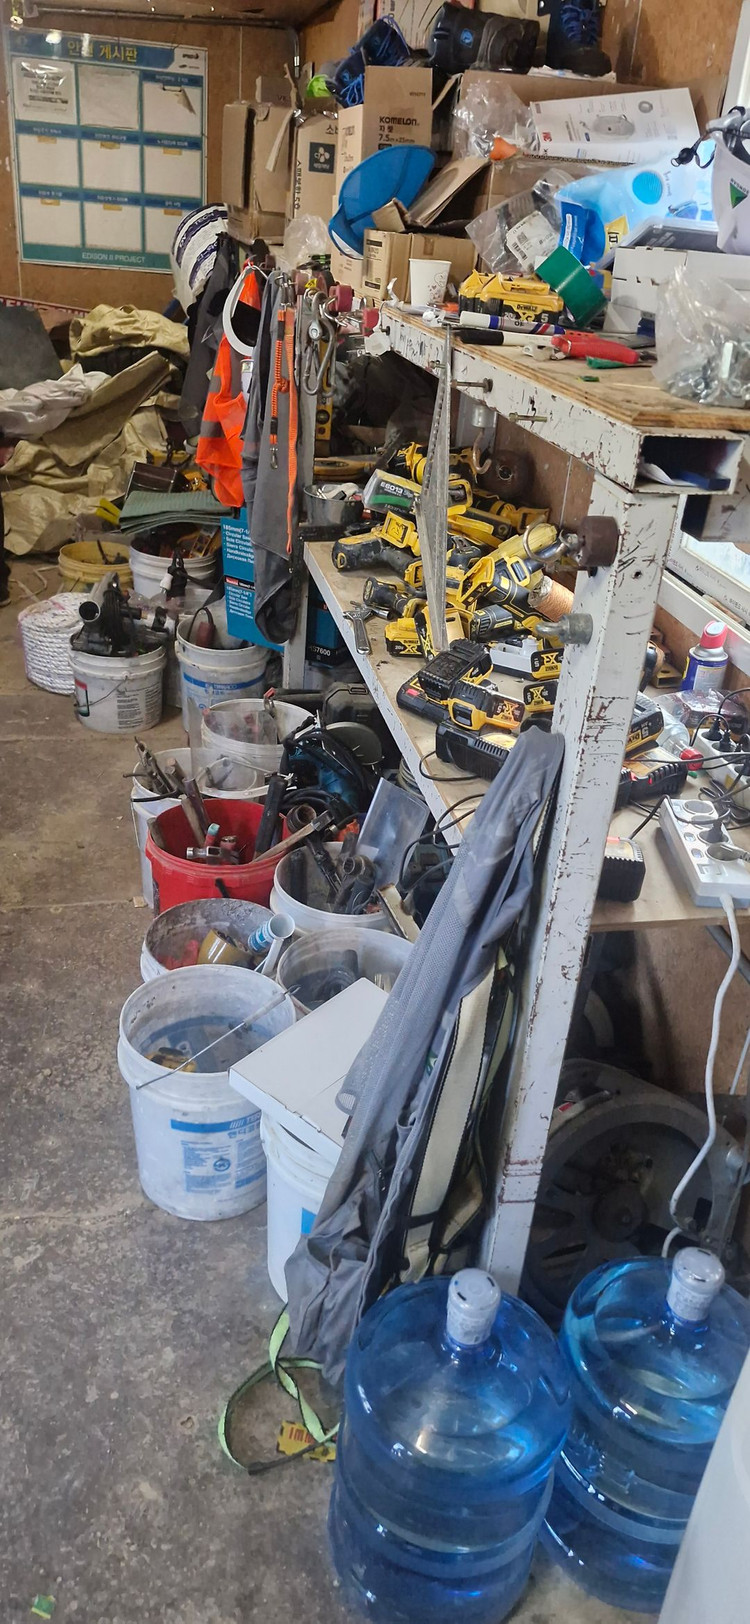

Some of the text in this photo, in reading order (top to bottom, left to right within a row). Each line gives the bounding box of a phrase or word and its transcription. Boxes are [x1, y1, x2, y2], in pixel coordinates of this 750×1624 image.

[99, 43, 138, 63] 게시판
[379, 115, 418, 127] KOMELON
[541, 131, 553, 142] 3M
[82, 251, 109, 261] EDISON
[114, 254, 146, 264] PROJECT
